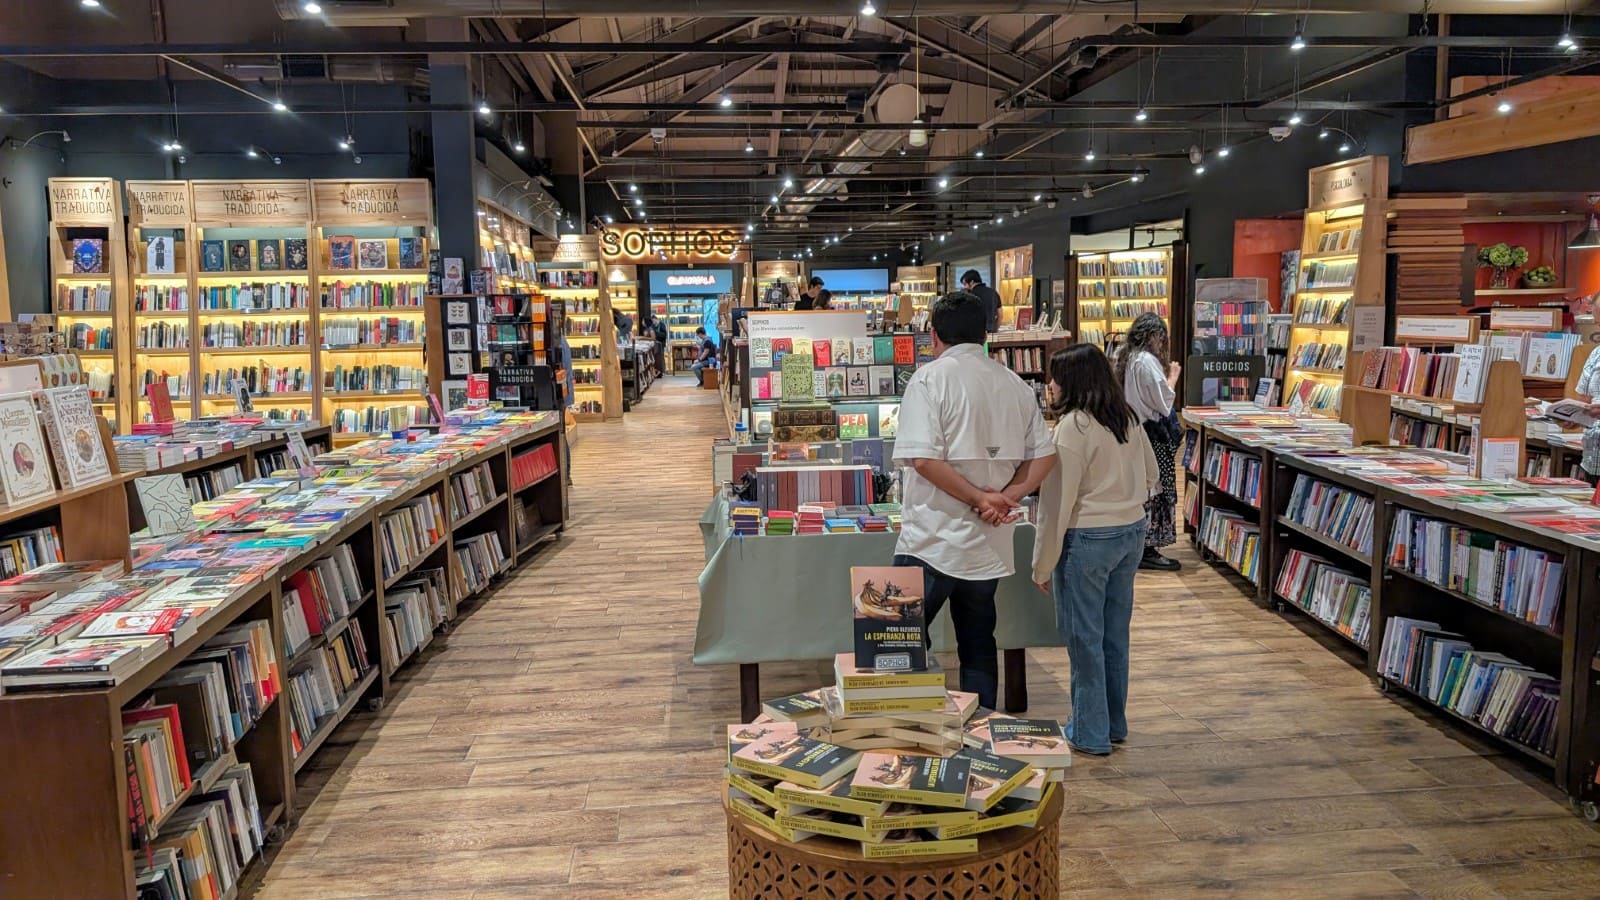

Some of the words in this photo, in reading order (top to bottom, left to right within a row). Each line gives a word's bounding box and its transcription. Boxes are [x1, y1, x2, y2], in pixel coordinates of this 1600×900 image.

[53, 187, 112, 200] NARRATIVA
[133, 191, 185, 201] NARRATIVA
[222, 189, 279, 201] NARRATIVA
[343, 188, 399, 200] NARRATIVA
[55, 201, 113, 214] TRADUCIDA
[135, 204, 186, 215] TRADUCIDA
[224, 203, 279, 215] TRADUCIDA
[346, 201, 399, 213] TRADUCIDA
[602, 229, 736, 256] SOPHOS
[1203, 361, 1250, 371] NEGOCIOS
[840, 414, 867, 426] PEA
[864, 632, 872, 641] LA
[873, 632, 906, 641] ESPERANZA
[906, 632, 922, 640] ROTA
[879, 658, 908, 668] SOPHOS
